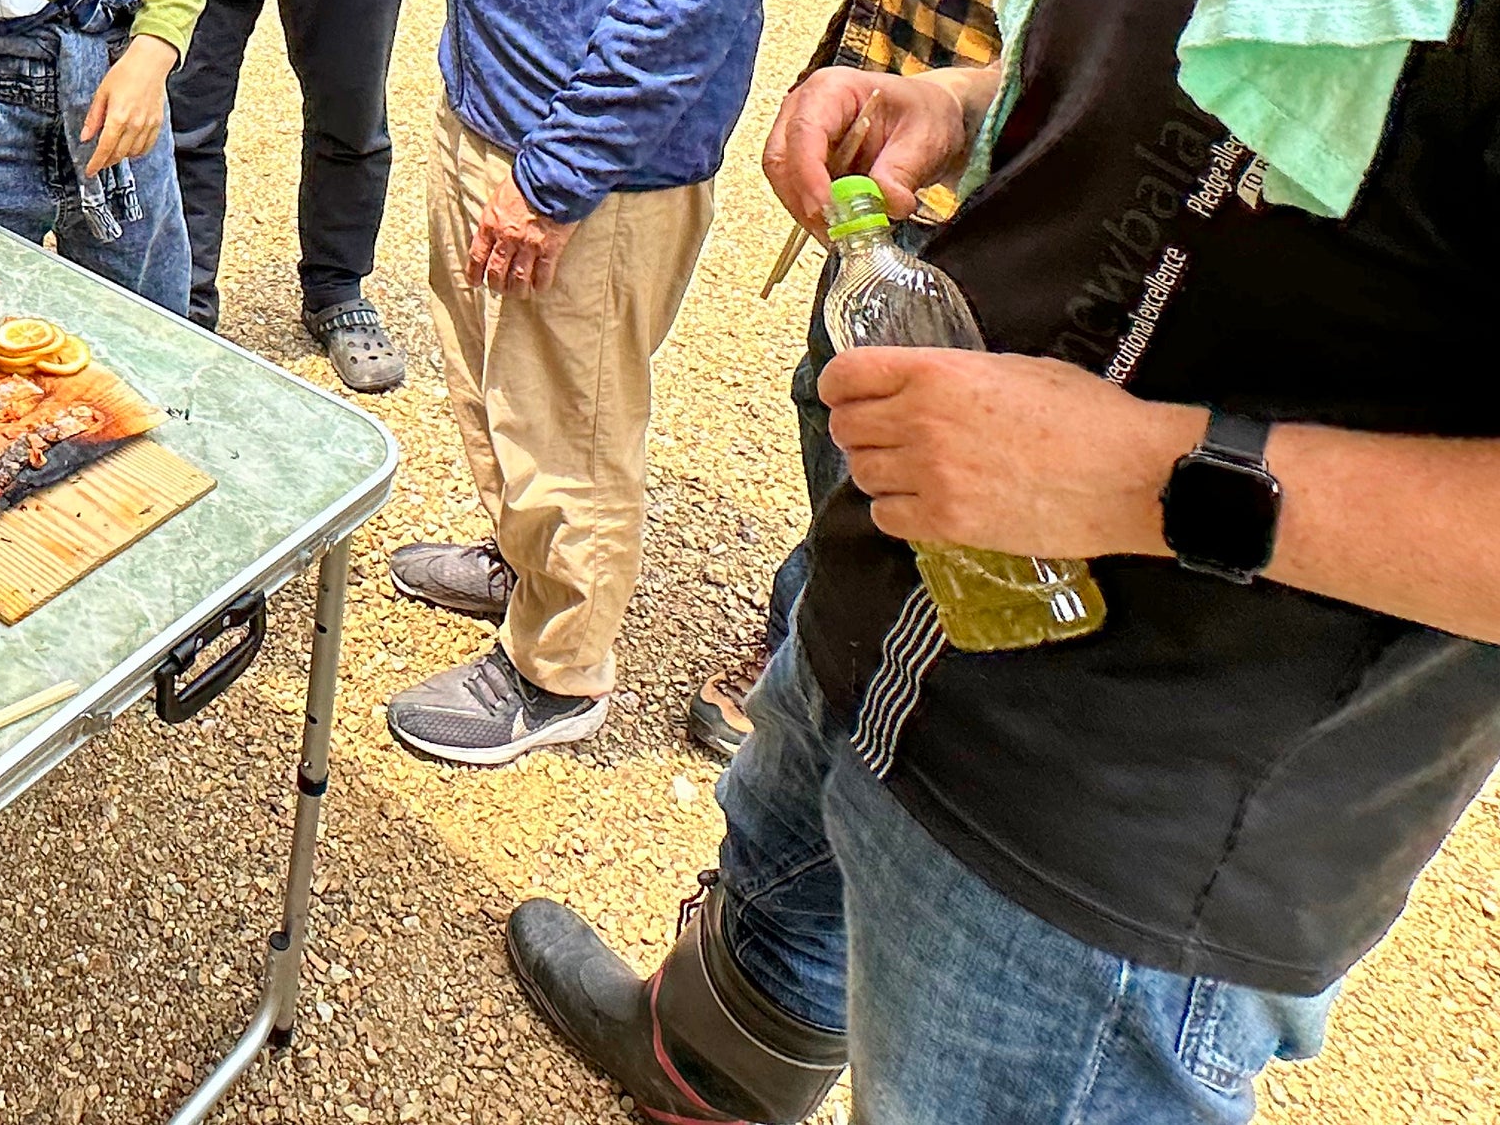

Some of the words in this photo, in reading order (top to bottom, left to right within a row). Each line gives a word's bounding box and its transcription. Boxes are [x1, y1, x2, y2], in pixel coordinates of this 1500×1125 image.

[1106, 311, 1156, 385] xecutional
[1138, 247, 1187, 321] excellence
[1187, 167, 1233, 219] Pledge
